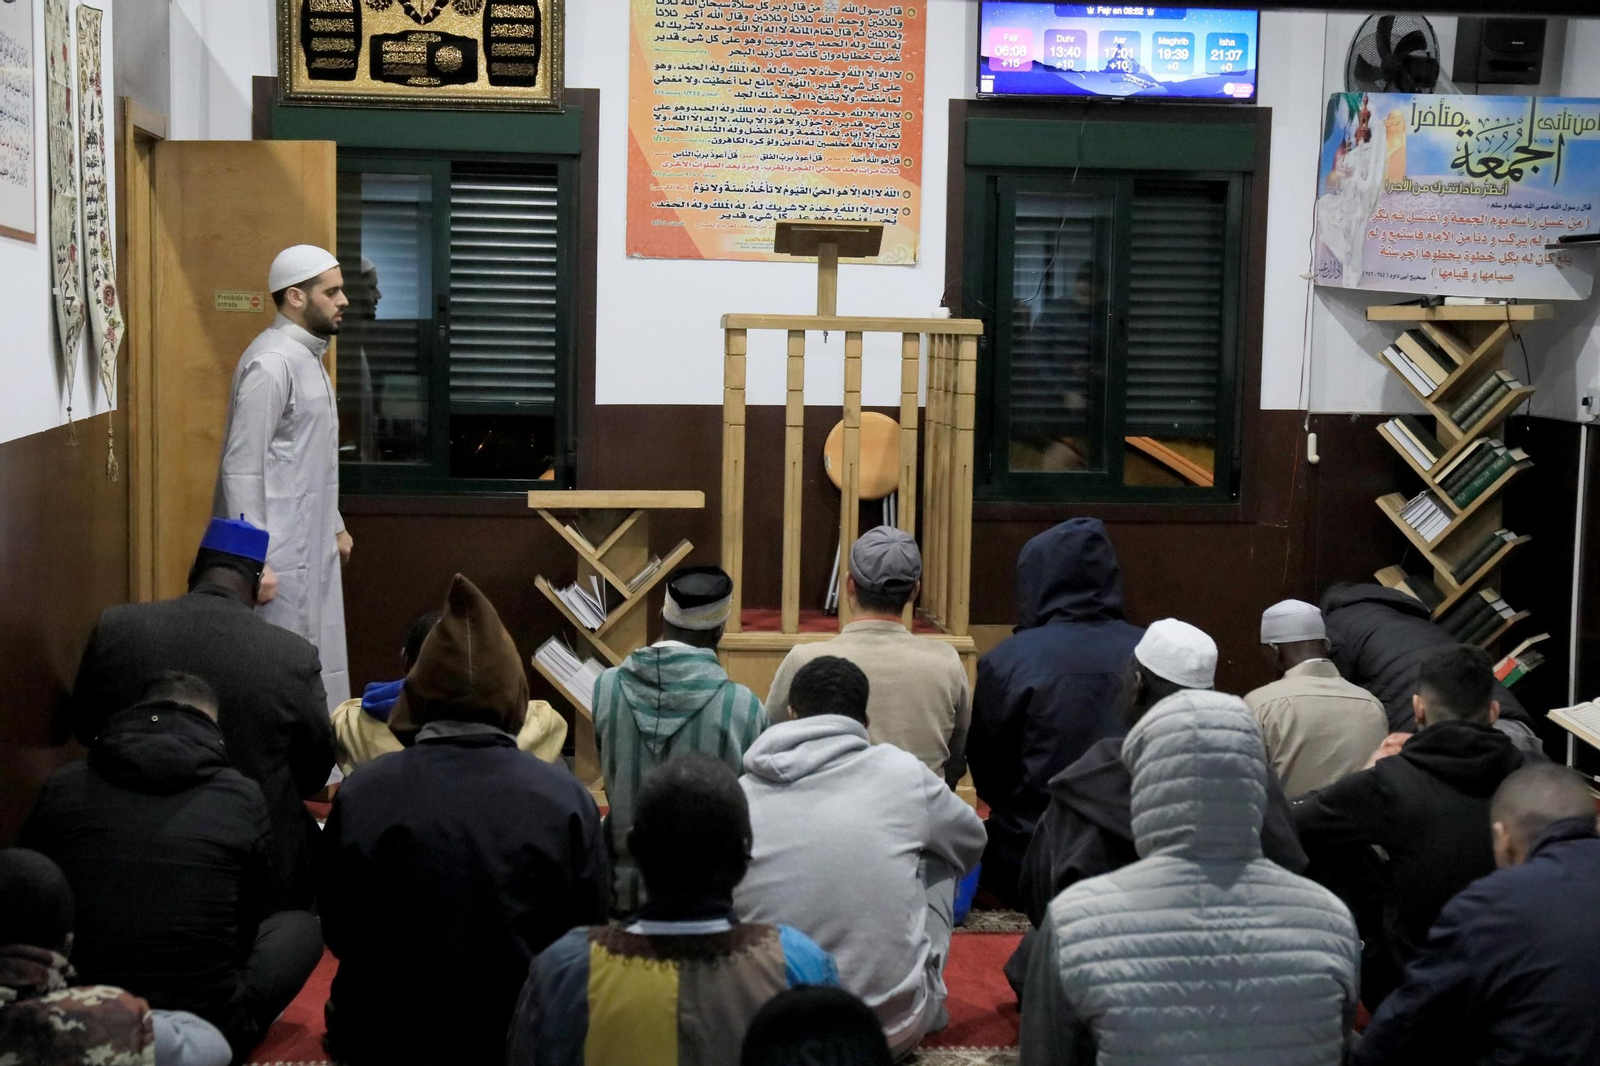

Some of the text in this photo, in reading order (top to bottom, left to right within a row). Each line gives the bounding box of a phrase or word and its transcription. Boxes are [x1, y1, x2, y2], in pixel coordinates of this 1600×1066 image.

[1097, 6, 1112, 16] Fajr
[1004, 34, 1018, 44] Fajr
[1056, 35, 1075, 43] Duhr
[1113, 36, 1126, 45] Asr
[1157, 36, 1189, 46] Maghrib
[1219, 38, 1236, 46] Isha
[995, 45, 1027, 57] 06:08
[1050, 46, 1081, 58] 13:40
[1104, 47, 1134, 59] 17:01
[1157, 48, 1189, 60] 19:39
[1210, 49, 1243, 61] 21:07
[1001, 58, 1020, 68] +15
[1056, 59, 1075, 69] +10
[1110, 60, 1128, 70] +10
[1166, 62, 1179, 71] +0
[1220, 63, 1233, 72] +0
